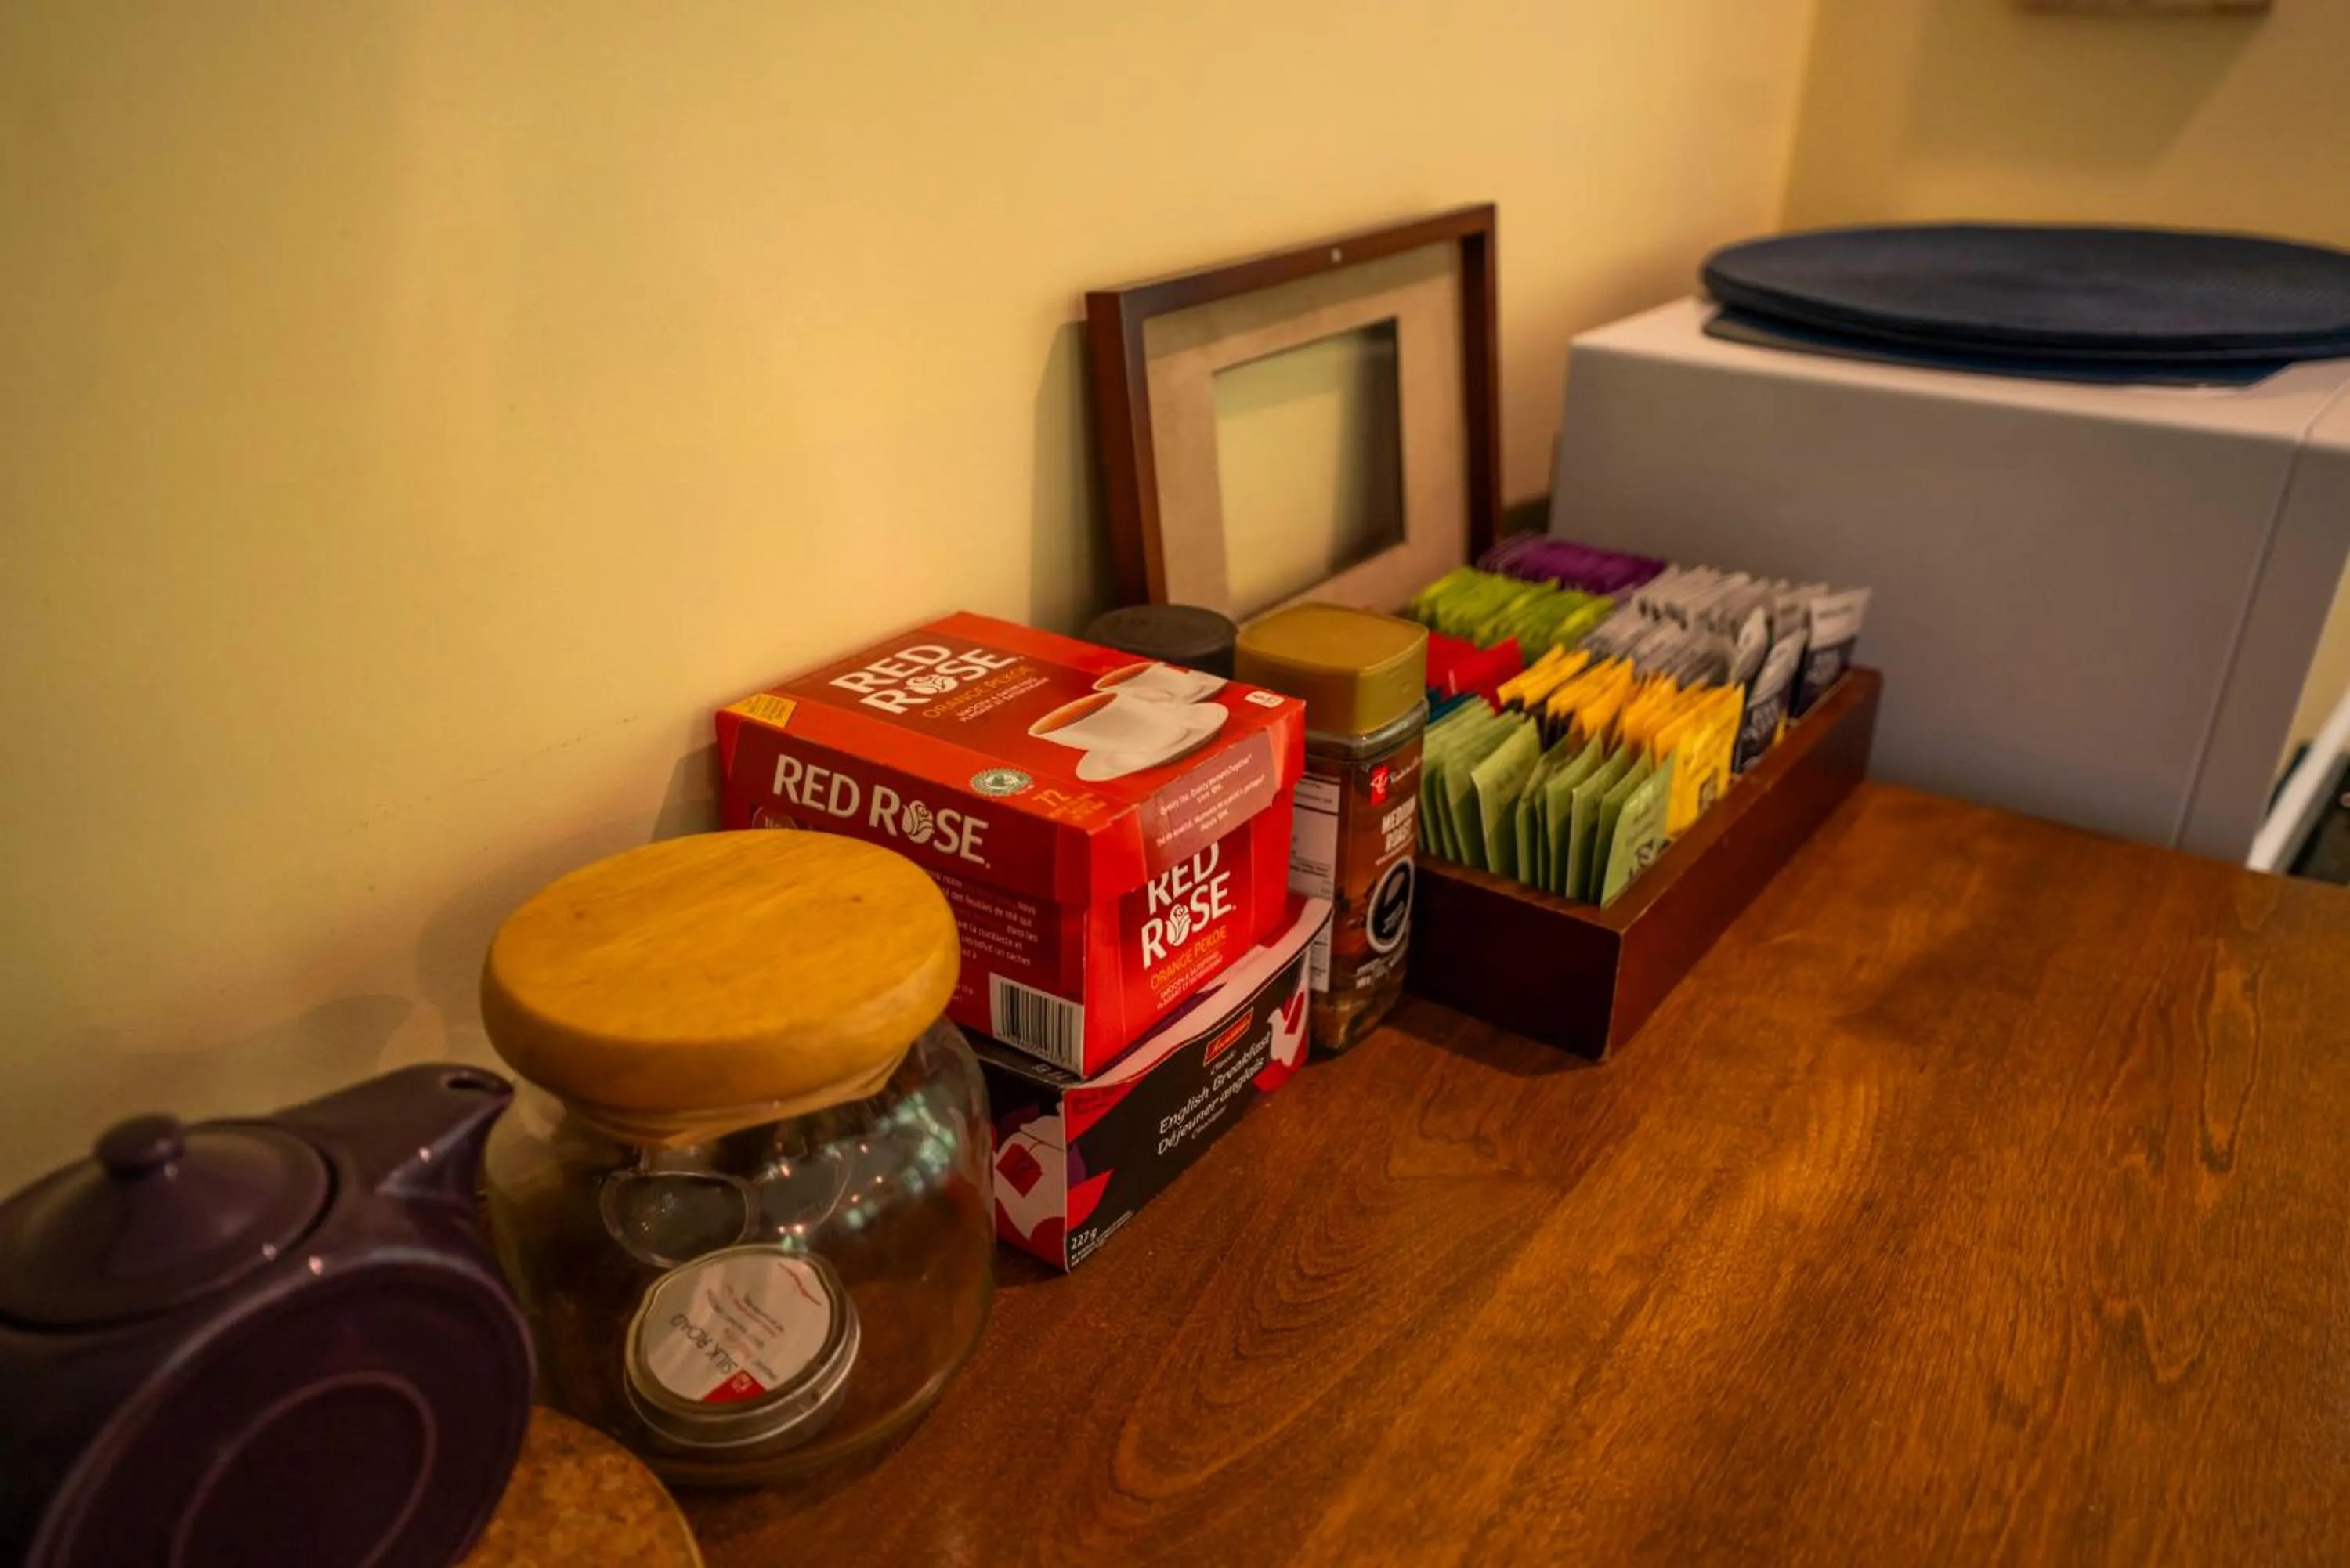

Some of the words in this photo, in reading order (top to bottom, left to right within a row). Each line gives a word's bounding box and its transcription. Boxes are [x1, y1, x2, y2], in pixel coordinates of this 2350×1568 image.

[829, 645, 951, 694] RED
[772, 754, 860, 818] RED
[1148, 841, 1220, 916] RED
[1151, 948, 1192, 990] ORANGE
[1194, 925, 1227, 957] PEKOE
[1159, 1086, 1209, 1134] English
[1213, 1031, 1271, 1091] Breakfast
[1071, 1230, 1090, 1251] 227
[705, 1342, 739, 1374] SILK
